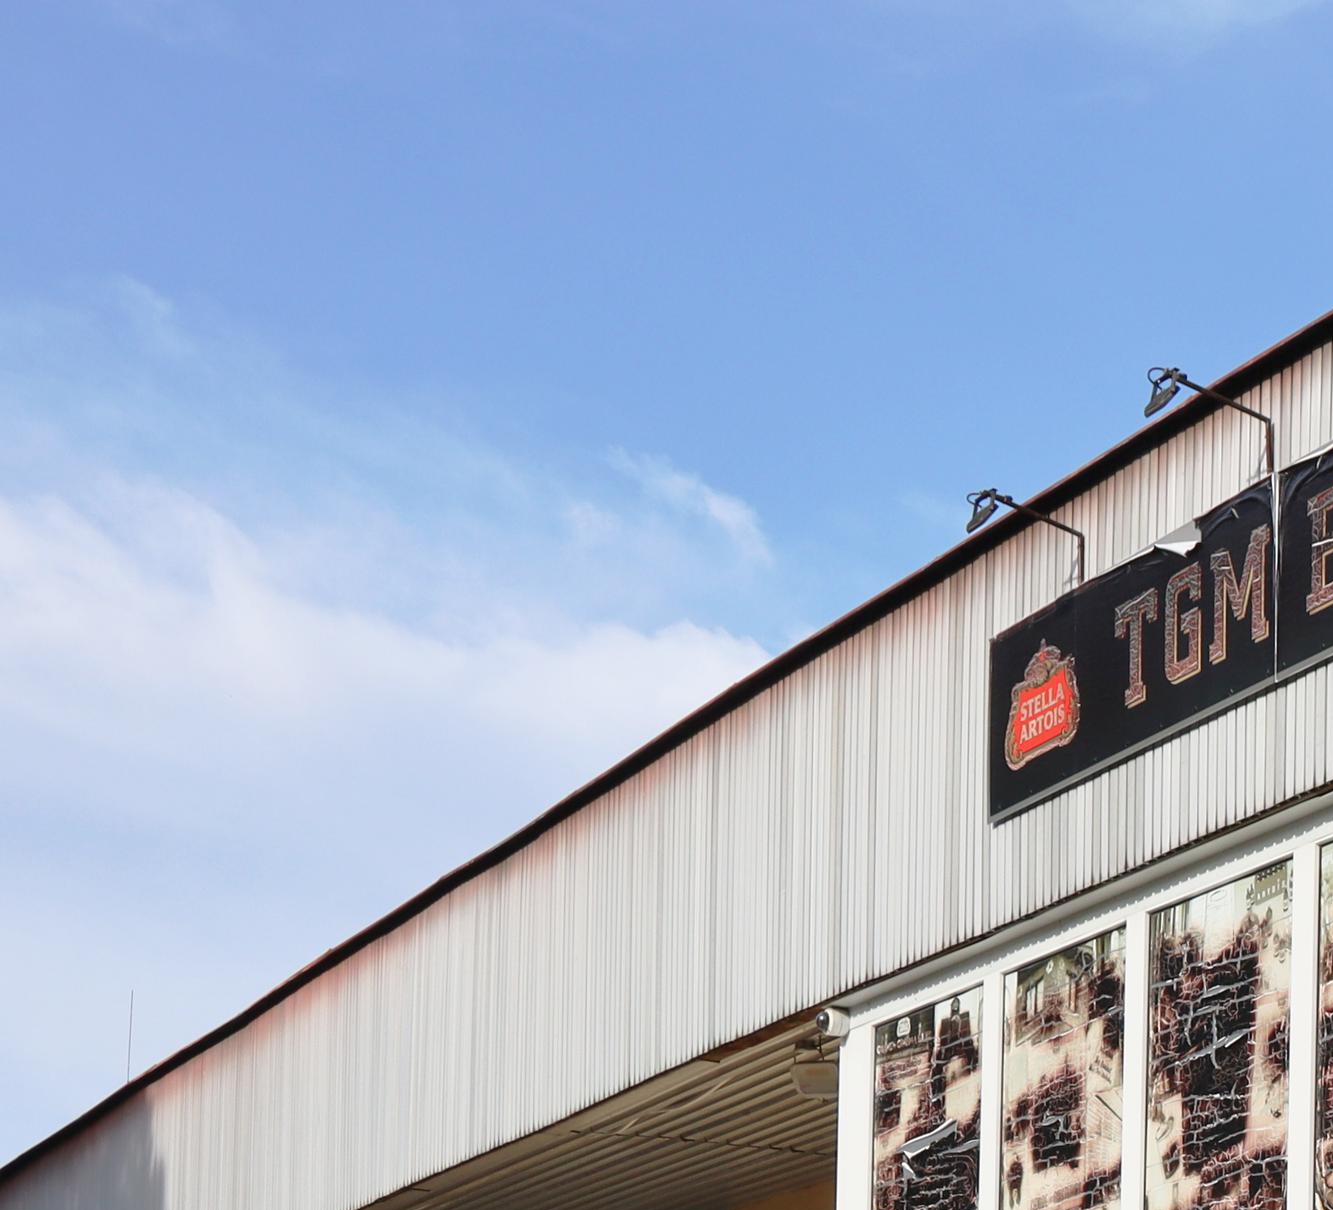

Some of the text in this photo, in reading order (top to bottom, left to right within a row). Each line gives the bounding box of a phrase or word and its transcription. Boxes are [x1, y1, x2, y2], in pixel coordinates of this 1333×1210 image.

[1114, 524, 1272, 709] TGM
[1019, 683, 1066, 723] STELLA
[1019, 706, 1066, 743] ARTOIS
